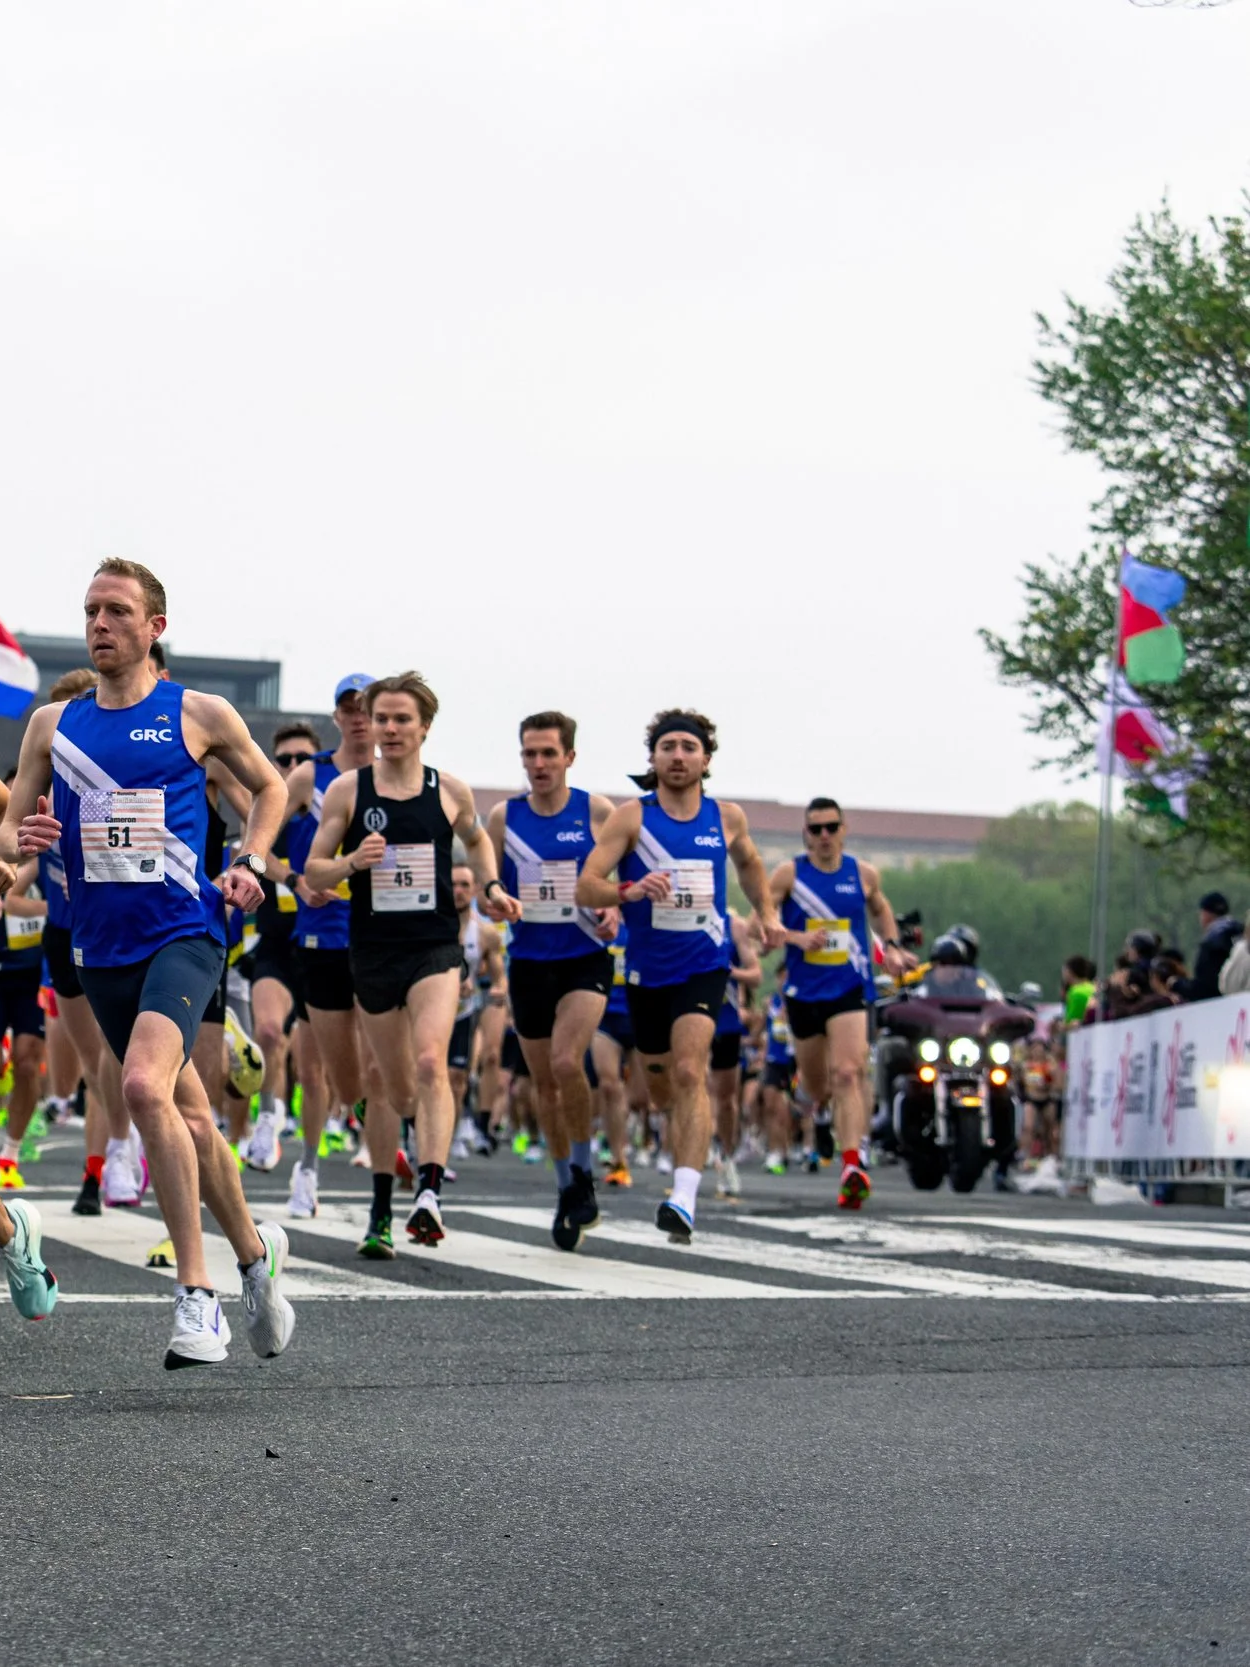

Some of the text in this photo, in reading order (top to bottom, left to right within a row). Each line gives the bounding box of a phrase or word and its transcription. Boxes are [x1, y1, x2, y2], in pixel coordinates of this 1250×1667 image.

[129, 728, 173, 744] GRC
[104, 815, 137, 823] Cameron
[107, 826, 133, 848] 51
[556, 831, 586, 843] GRC
[694, 835, 723, 848] GRC
[394, 871, 413, 888] 45
[539, 885, 556, 901] 91
[674, 893, 693, 909] 39
